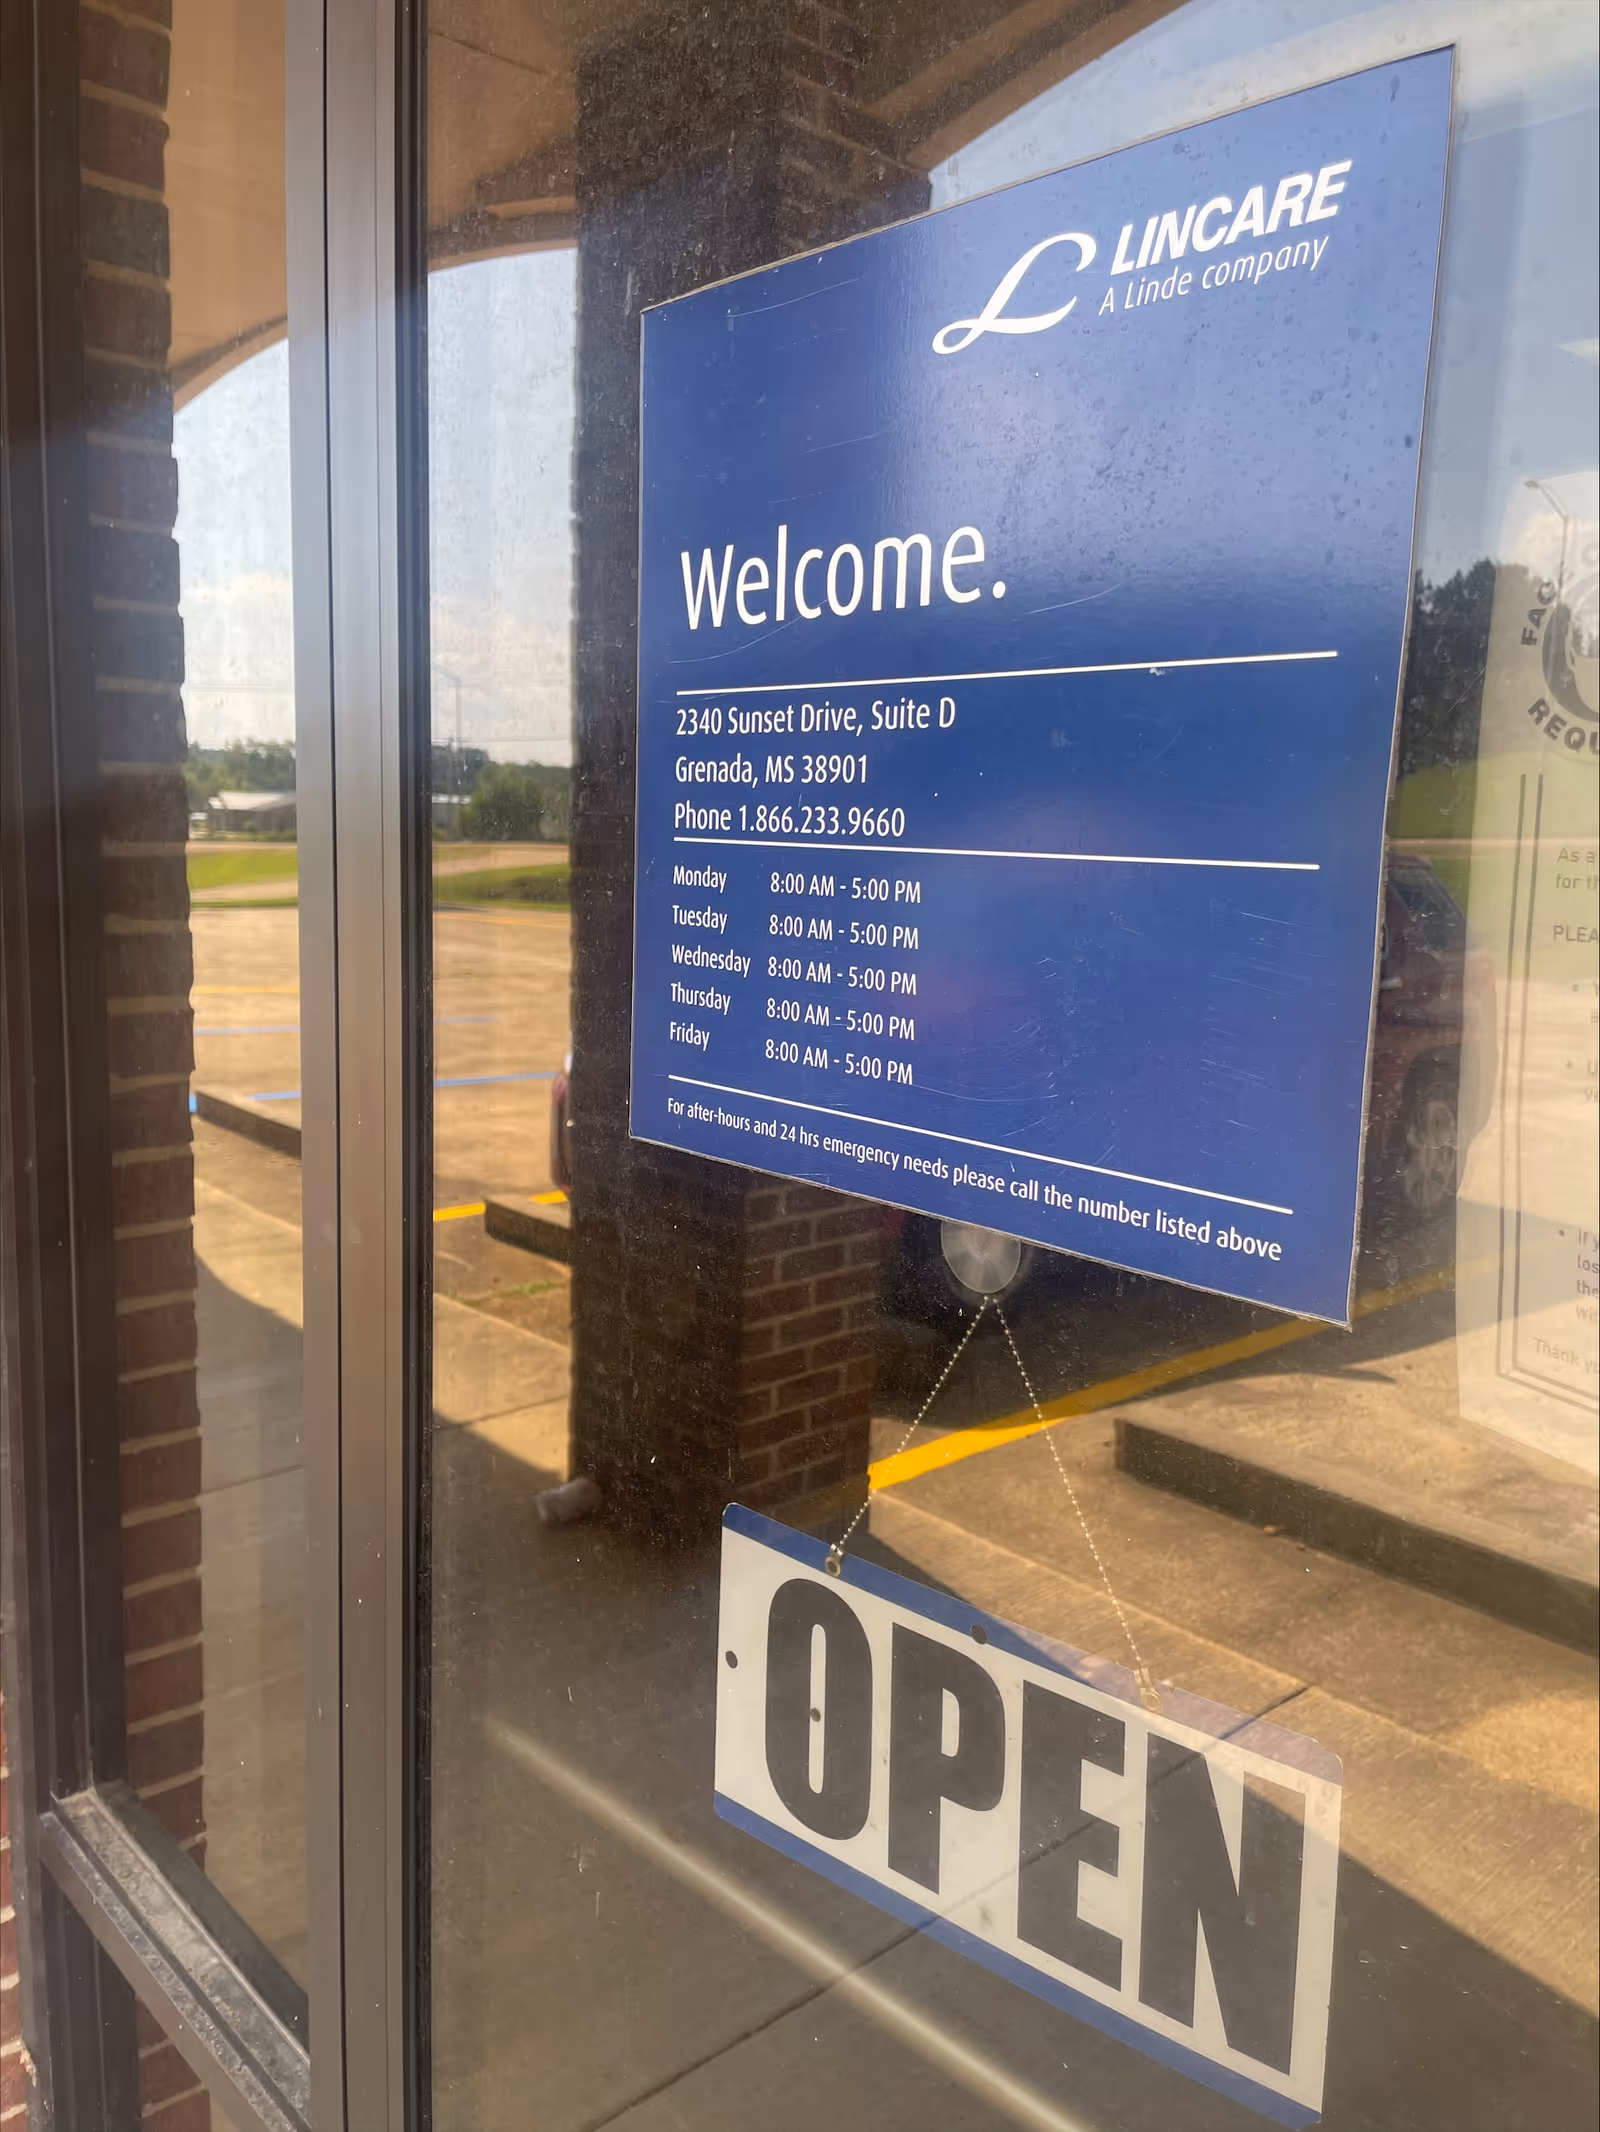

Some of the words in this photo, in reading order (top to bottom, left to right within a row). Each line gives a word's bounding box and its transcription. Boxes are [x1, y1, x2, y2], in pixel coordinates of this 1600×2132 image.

[1110, 160, 1352, 276] LINCARE
[1098, 288, 1115, 315] A
[1125, 267, 1192, 311] Linde
[1203, 235, 1329, 289] company
[681, 524, 1006, 630] Welcome.
[676, 708, 722, 735] 2340
[728, 704, 793, 734] Sunset
[801, 701, 864, 736] Drive,
[871, 697, 930, 730] Suite
[939, 697, 956, 728] D
[675, 752, 758, 788] Grenada,
[765, 755, 794, 783] MS
[801, 755, 867, 783] 38901
[674, 800, 731, 831] Phone
[738, 805, 905, 837] 1.866.233.9660
[1557, 847, 1580, 863] As
[673, 865, 727, 893] Monday
[770, 872, 804, 894] 8:00
[809, 875, 834, 897] AM
[851, 877, 888, 901] 5:00
[895, 880, 921, 903] PM
[1556, 873, 1581, 889] for
[672, 905, 727, 934] Tuesday
[769, 914, 803, 937] 8:00
[807, 918, 832, 940] AM
[850, 922, 886, 946] 5:00
[893, 926, 919, 949] PM
[672, 944, 751, 977] Wednesday
[768, 956, 801, 979] 8:00
[806, 961, 831, 983] AM
[848, 966, 885, 990] 5:00
[891, 971, 916, 995] PM
[671, 982, 730, 1015] Thursday
[766, 998, 800, 1021] 8:00
[804, 1004, 829, 1026] AM
[846, 1010, 883, 1035] 5:00
[889, 1016, 915, 1040] PM
[670, 1021, 710, 1051] Friday
[765, 1039, 798, 1063] 8:00
[803, 1046, 828, 1069] AM
[845, 1053, 881, 1079] 5:00
[887, 1060, 912, 1085] PM
[668, 1098, 684, 1116] For
[688, 1102, 750, 1131] after-hours
[753, 1119, 776, 1137] and
[780, 1123, 796, 1142] 24
[800, 1126, 819, 1147] hrs
[823, 1135, 899, 1170] emergency
[904, 1154, 949, 1179] needs
[953, 1163, 1005, 1193] please
[1010, 1179, 1038, 1201] call
[1044, 1184, 1072, 1210] the
[1078, 1196, 1150, 1228] number
[1156, 1209, 1210, 1244] listed
[1216, 1227, 1282, 1261] above
[1533, 1337, 1580, 1365] Thank
[765, 1578, 1306, 2076] OPEN
